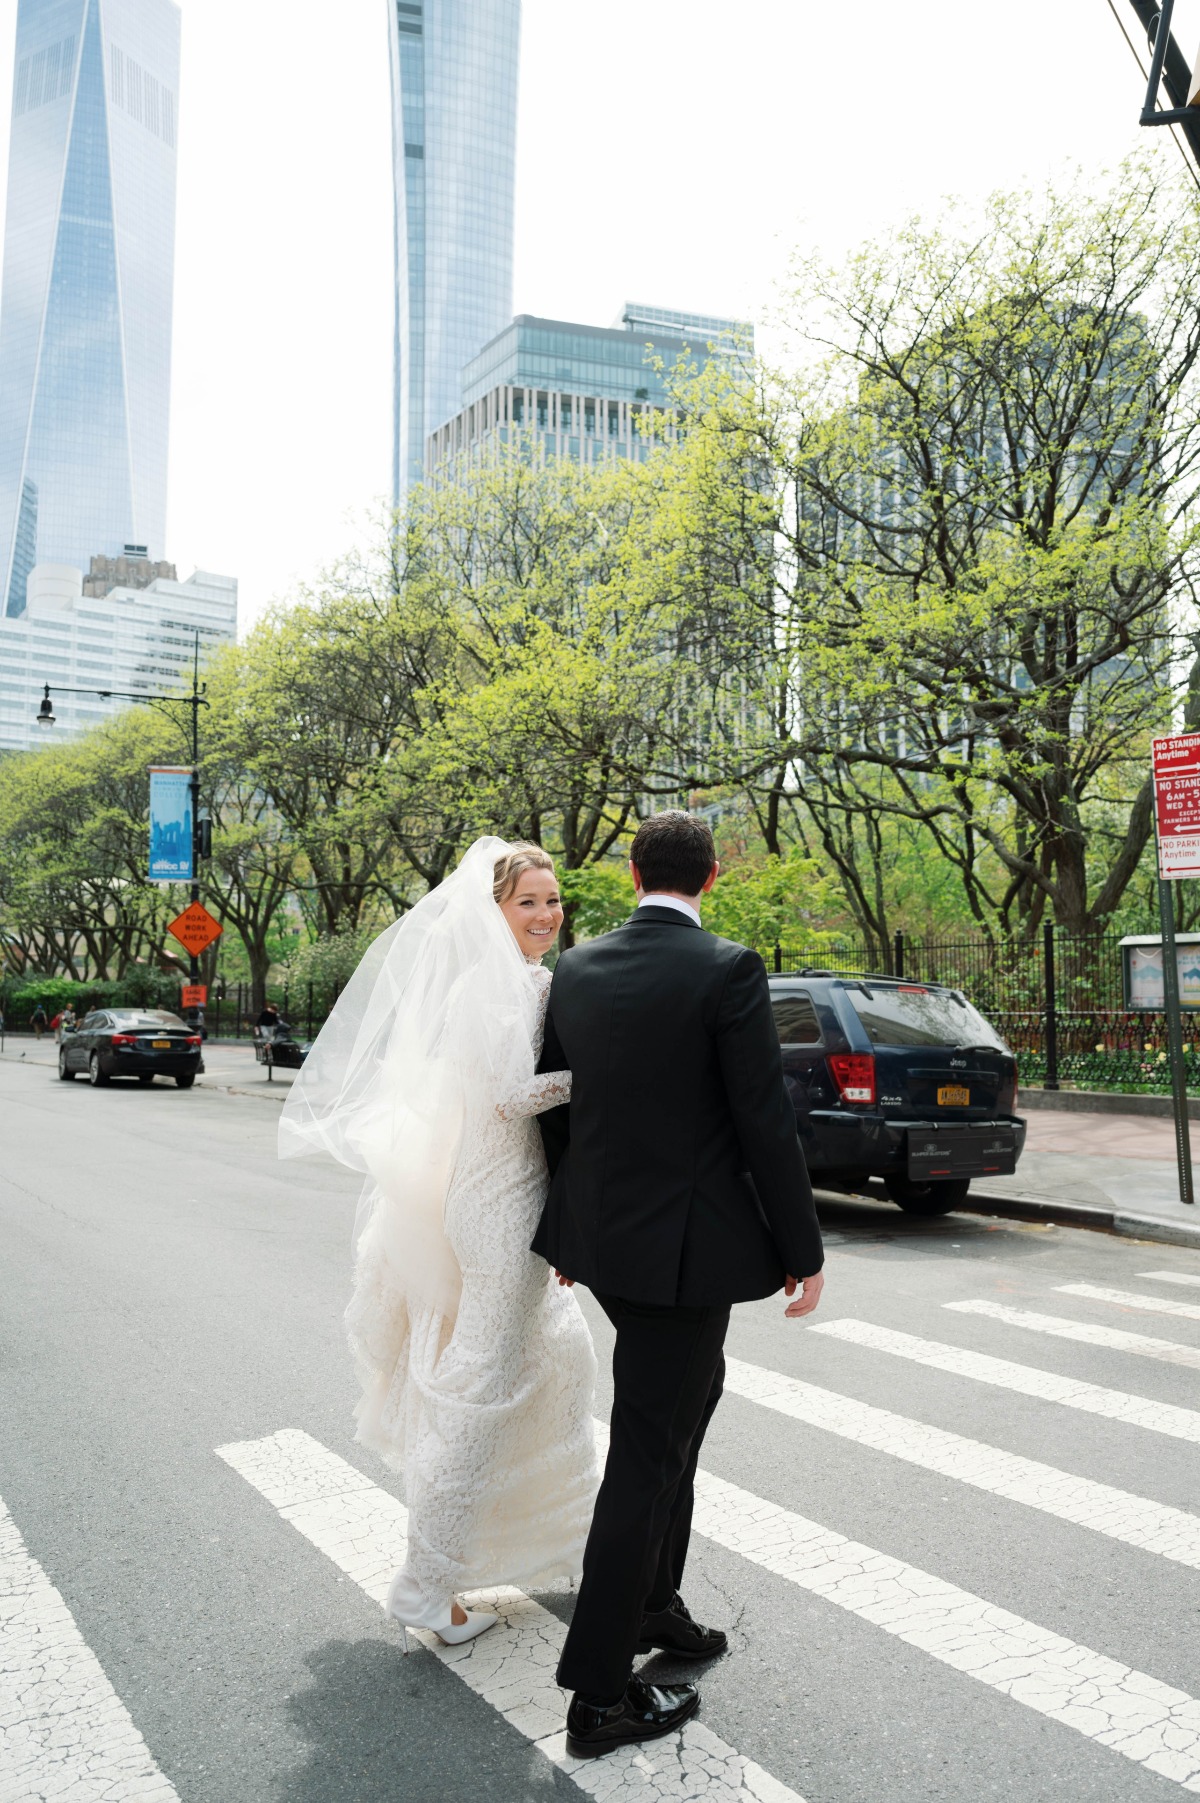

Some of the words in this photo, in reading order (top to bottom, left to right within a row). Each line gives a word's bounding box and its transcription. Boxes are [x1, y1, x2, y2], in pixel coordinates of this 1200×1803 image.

[1156, 742, 1167, 751] NO
[1157, 750, 1189, 760] Anytime
[1160, 782, 1171, 791] NO
[1166, 802, 1183, 810] WED
[1164, 850, 1196, 859] Anytime
[185, 914, 207, 922] ROAD
[183, 934, 209, 942] AHEAD
[950, 1058, 967, 1068] Jeep
